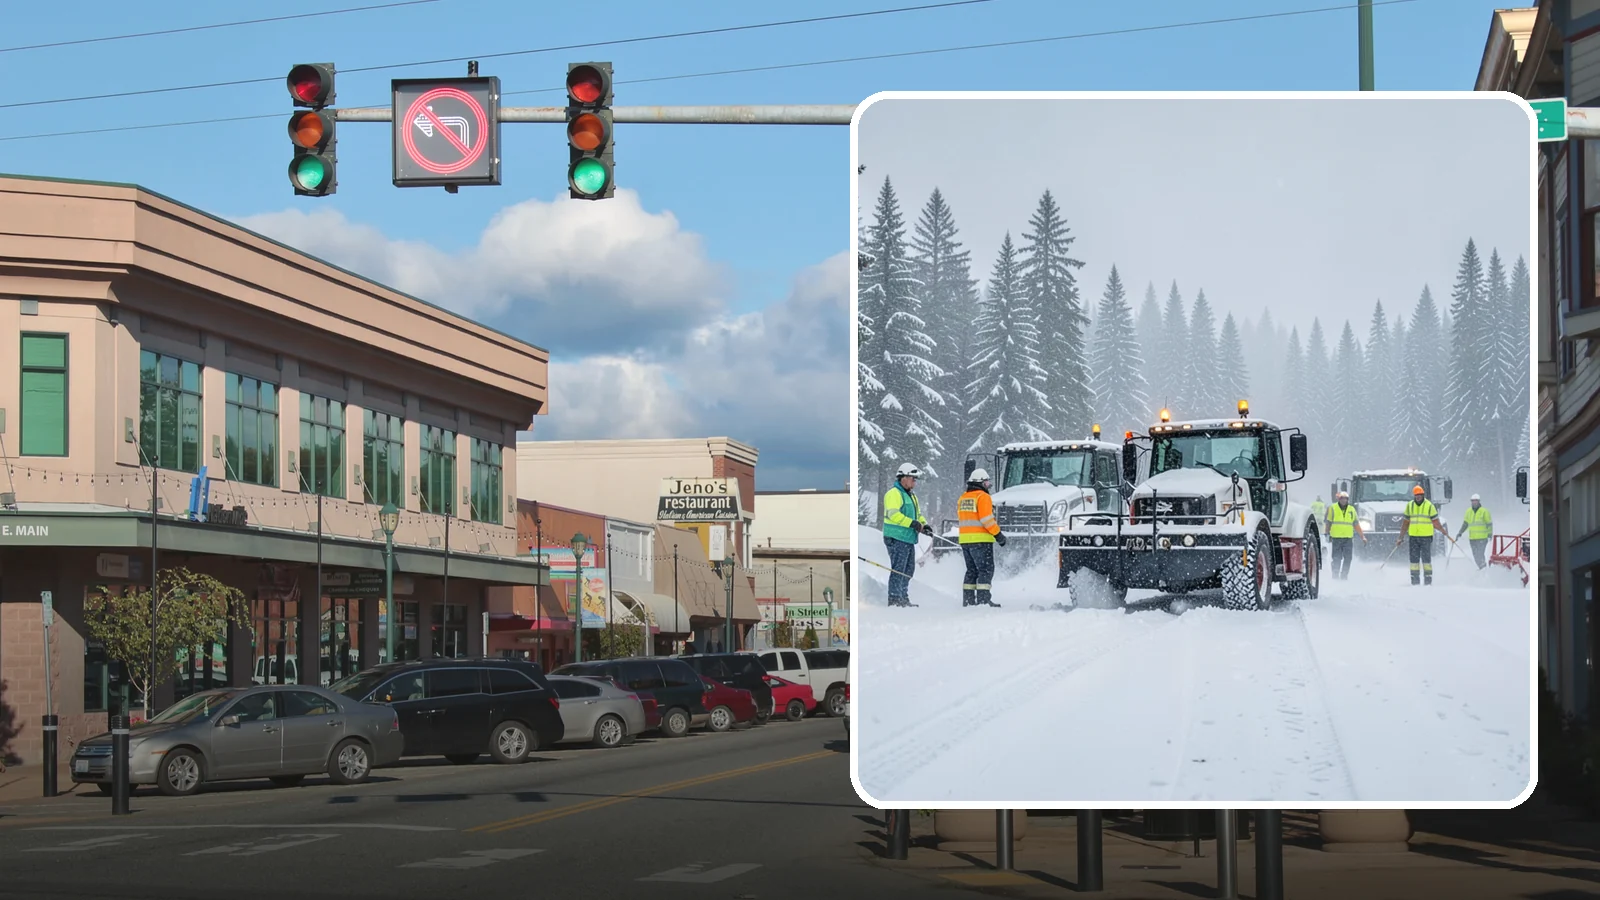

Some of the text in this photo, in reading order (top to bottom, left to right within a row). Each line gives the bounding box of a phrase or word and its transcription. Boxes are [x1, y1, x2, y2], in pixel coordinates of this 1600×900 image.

[670, 480, 727, 494] Jeno's
[665, 496, 730, 508] restaurant
[659, 510, 681, 519] Italian
[686, 510, 714, 519] American
[715, 509, 737, 519] Cuisine
[2, 525, 49, 536] E. MAIN
[797, 607, 828, 616] Street
